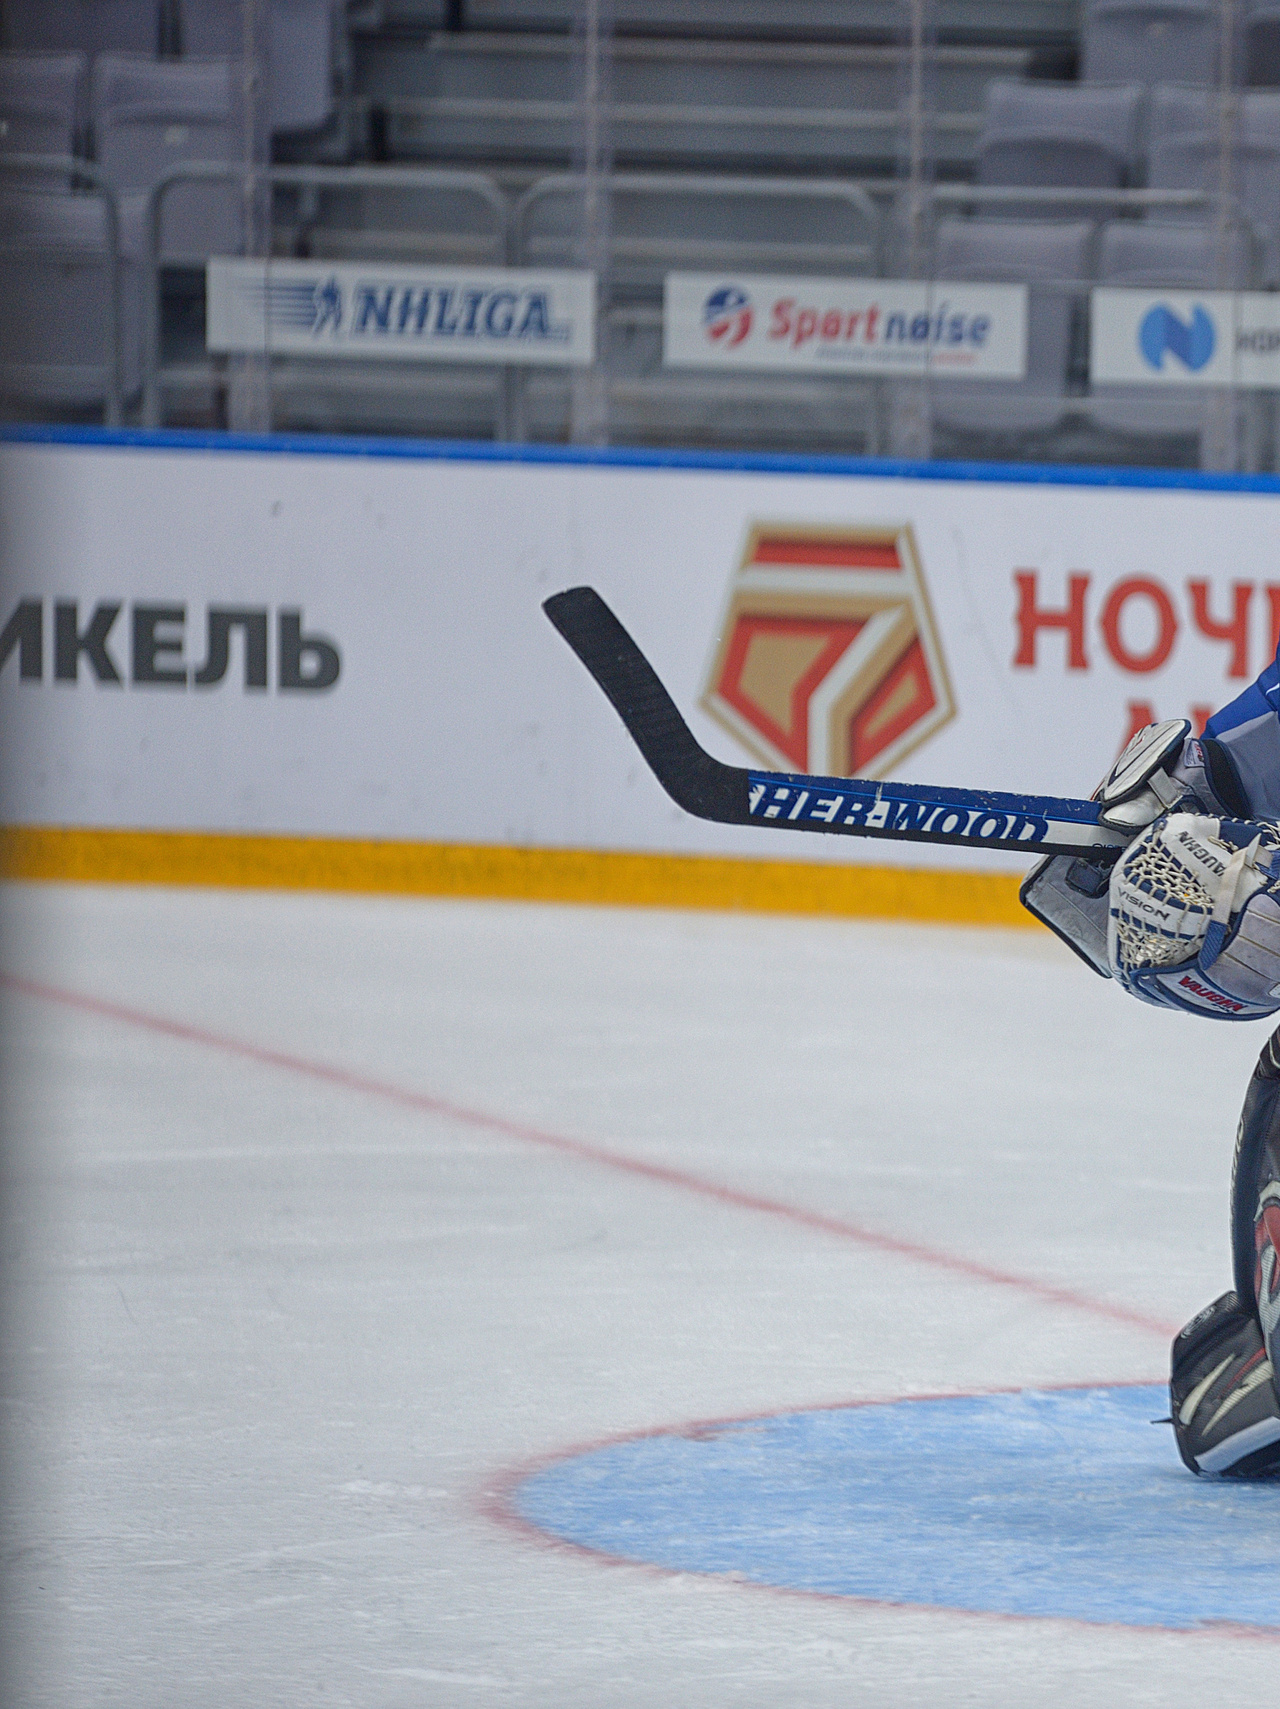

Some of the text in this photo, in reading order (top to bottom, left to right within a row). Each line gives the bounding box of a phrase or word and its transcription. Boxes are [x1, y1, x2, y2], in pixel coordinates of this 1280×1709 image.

[356, 284, 553, 337] NHLIGA
[1178, 831, 1226, 877] AUGHN
[1117, 887, 1171, 921] VISION
[1178, 976, 1247, 1012] VAUGHN
